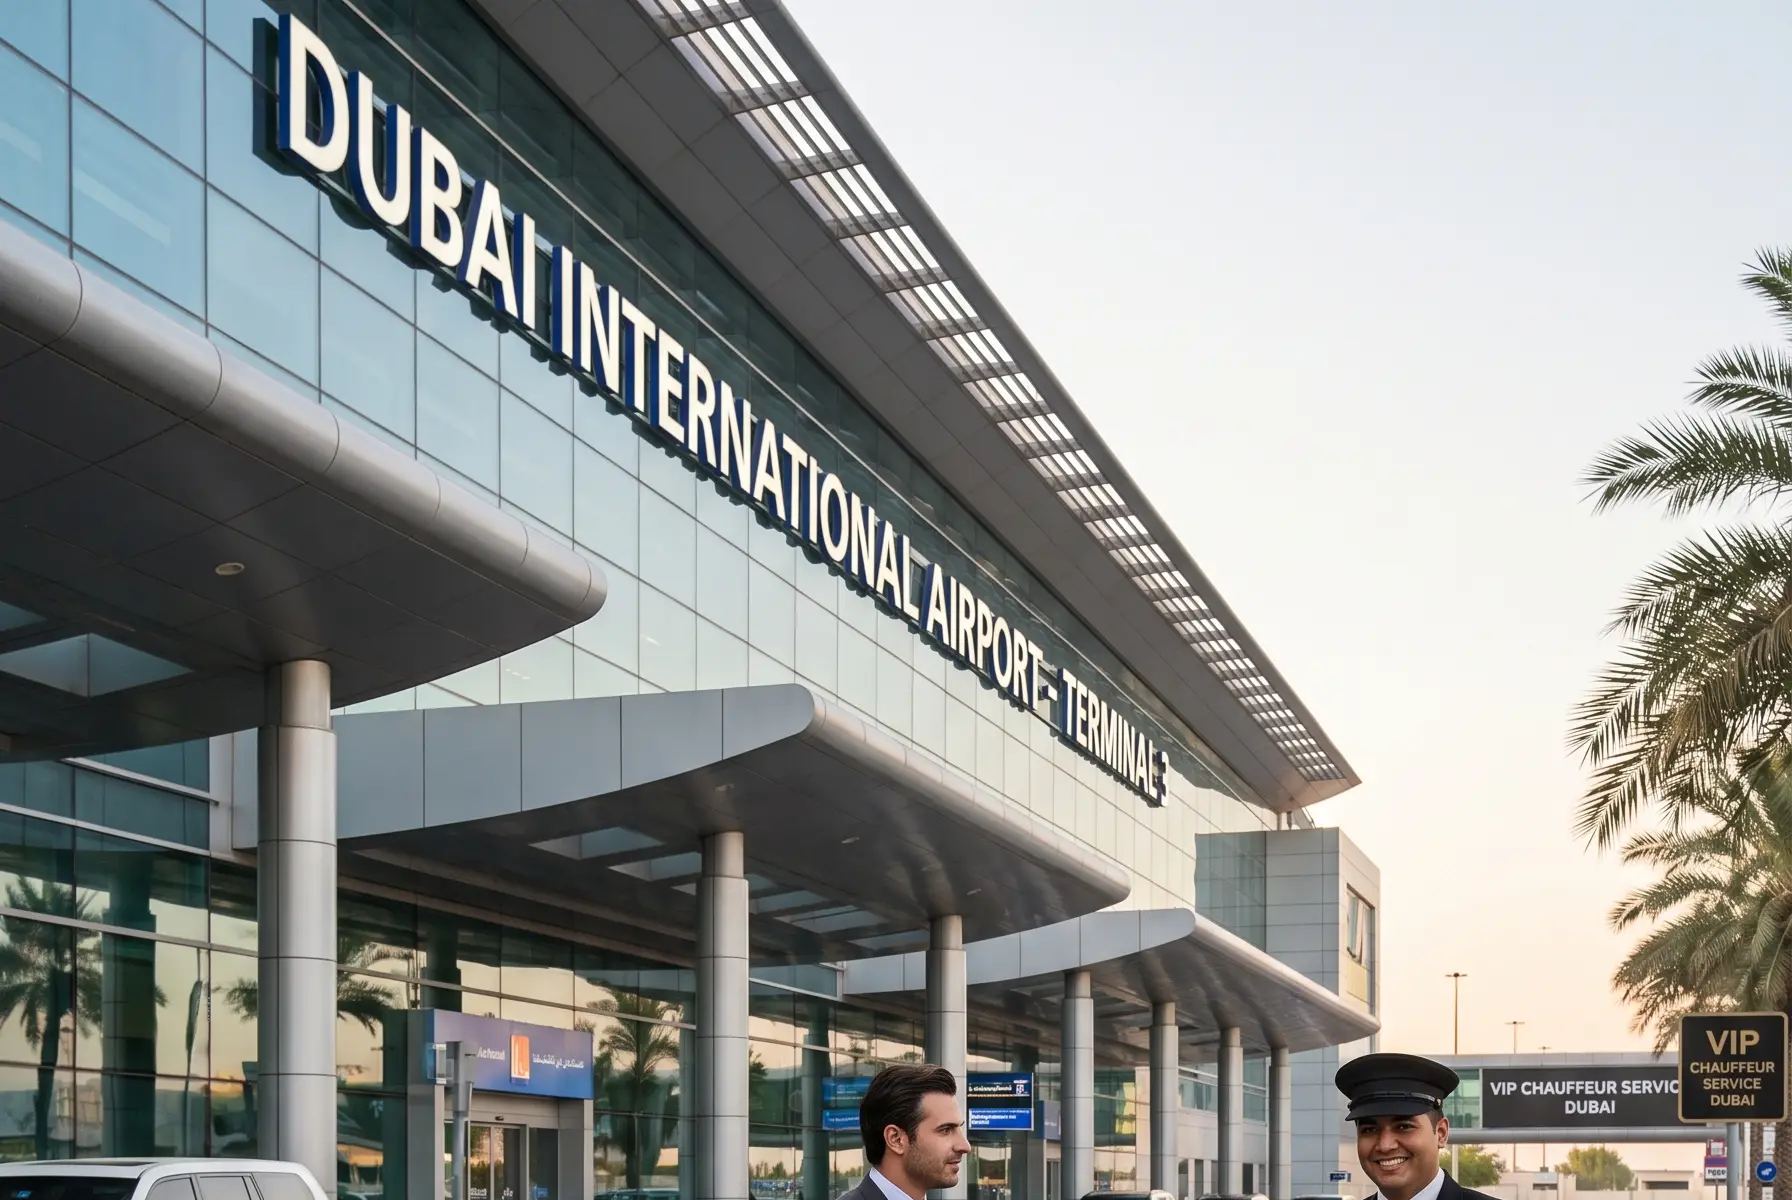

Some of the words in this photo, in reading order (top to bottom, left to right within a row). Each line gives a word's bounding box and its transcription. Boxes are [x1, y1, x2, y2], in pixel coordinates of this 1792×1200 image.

[279, 14, 536, 330] DUBAI
[552, 246, 919, 621] INTERNATIONAL
[922, 563, 1043, 711] AIRPORT
[1059, 667, 1158, 800] TERMINAL
[1159, 751, 1170, 807] 3
[1705, 1029, 1760, 1056] VIP
[1689, 1061, 1776, 1074] CHAUFFEUR
[1489, 1081, 1518, 1096] VIP
[1520, 1080, 1618, 1096] CHAUFFEUR
[1620, 1079, 1679, 1095] SERVIC
[1702, 1077, 1762, 1090] SERVICE
[1564, 1100, 1616, 1115] DUBAI
[1710, 1094, 1756, 1107] DUBAI
